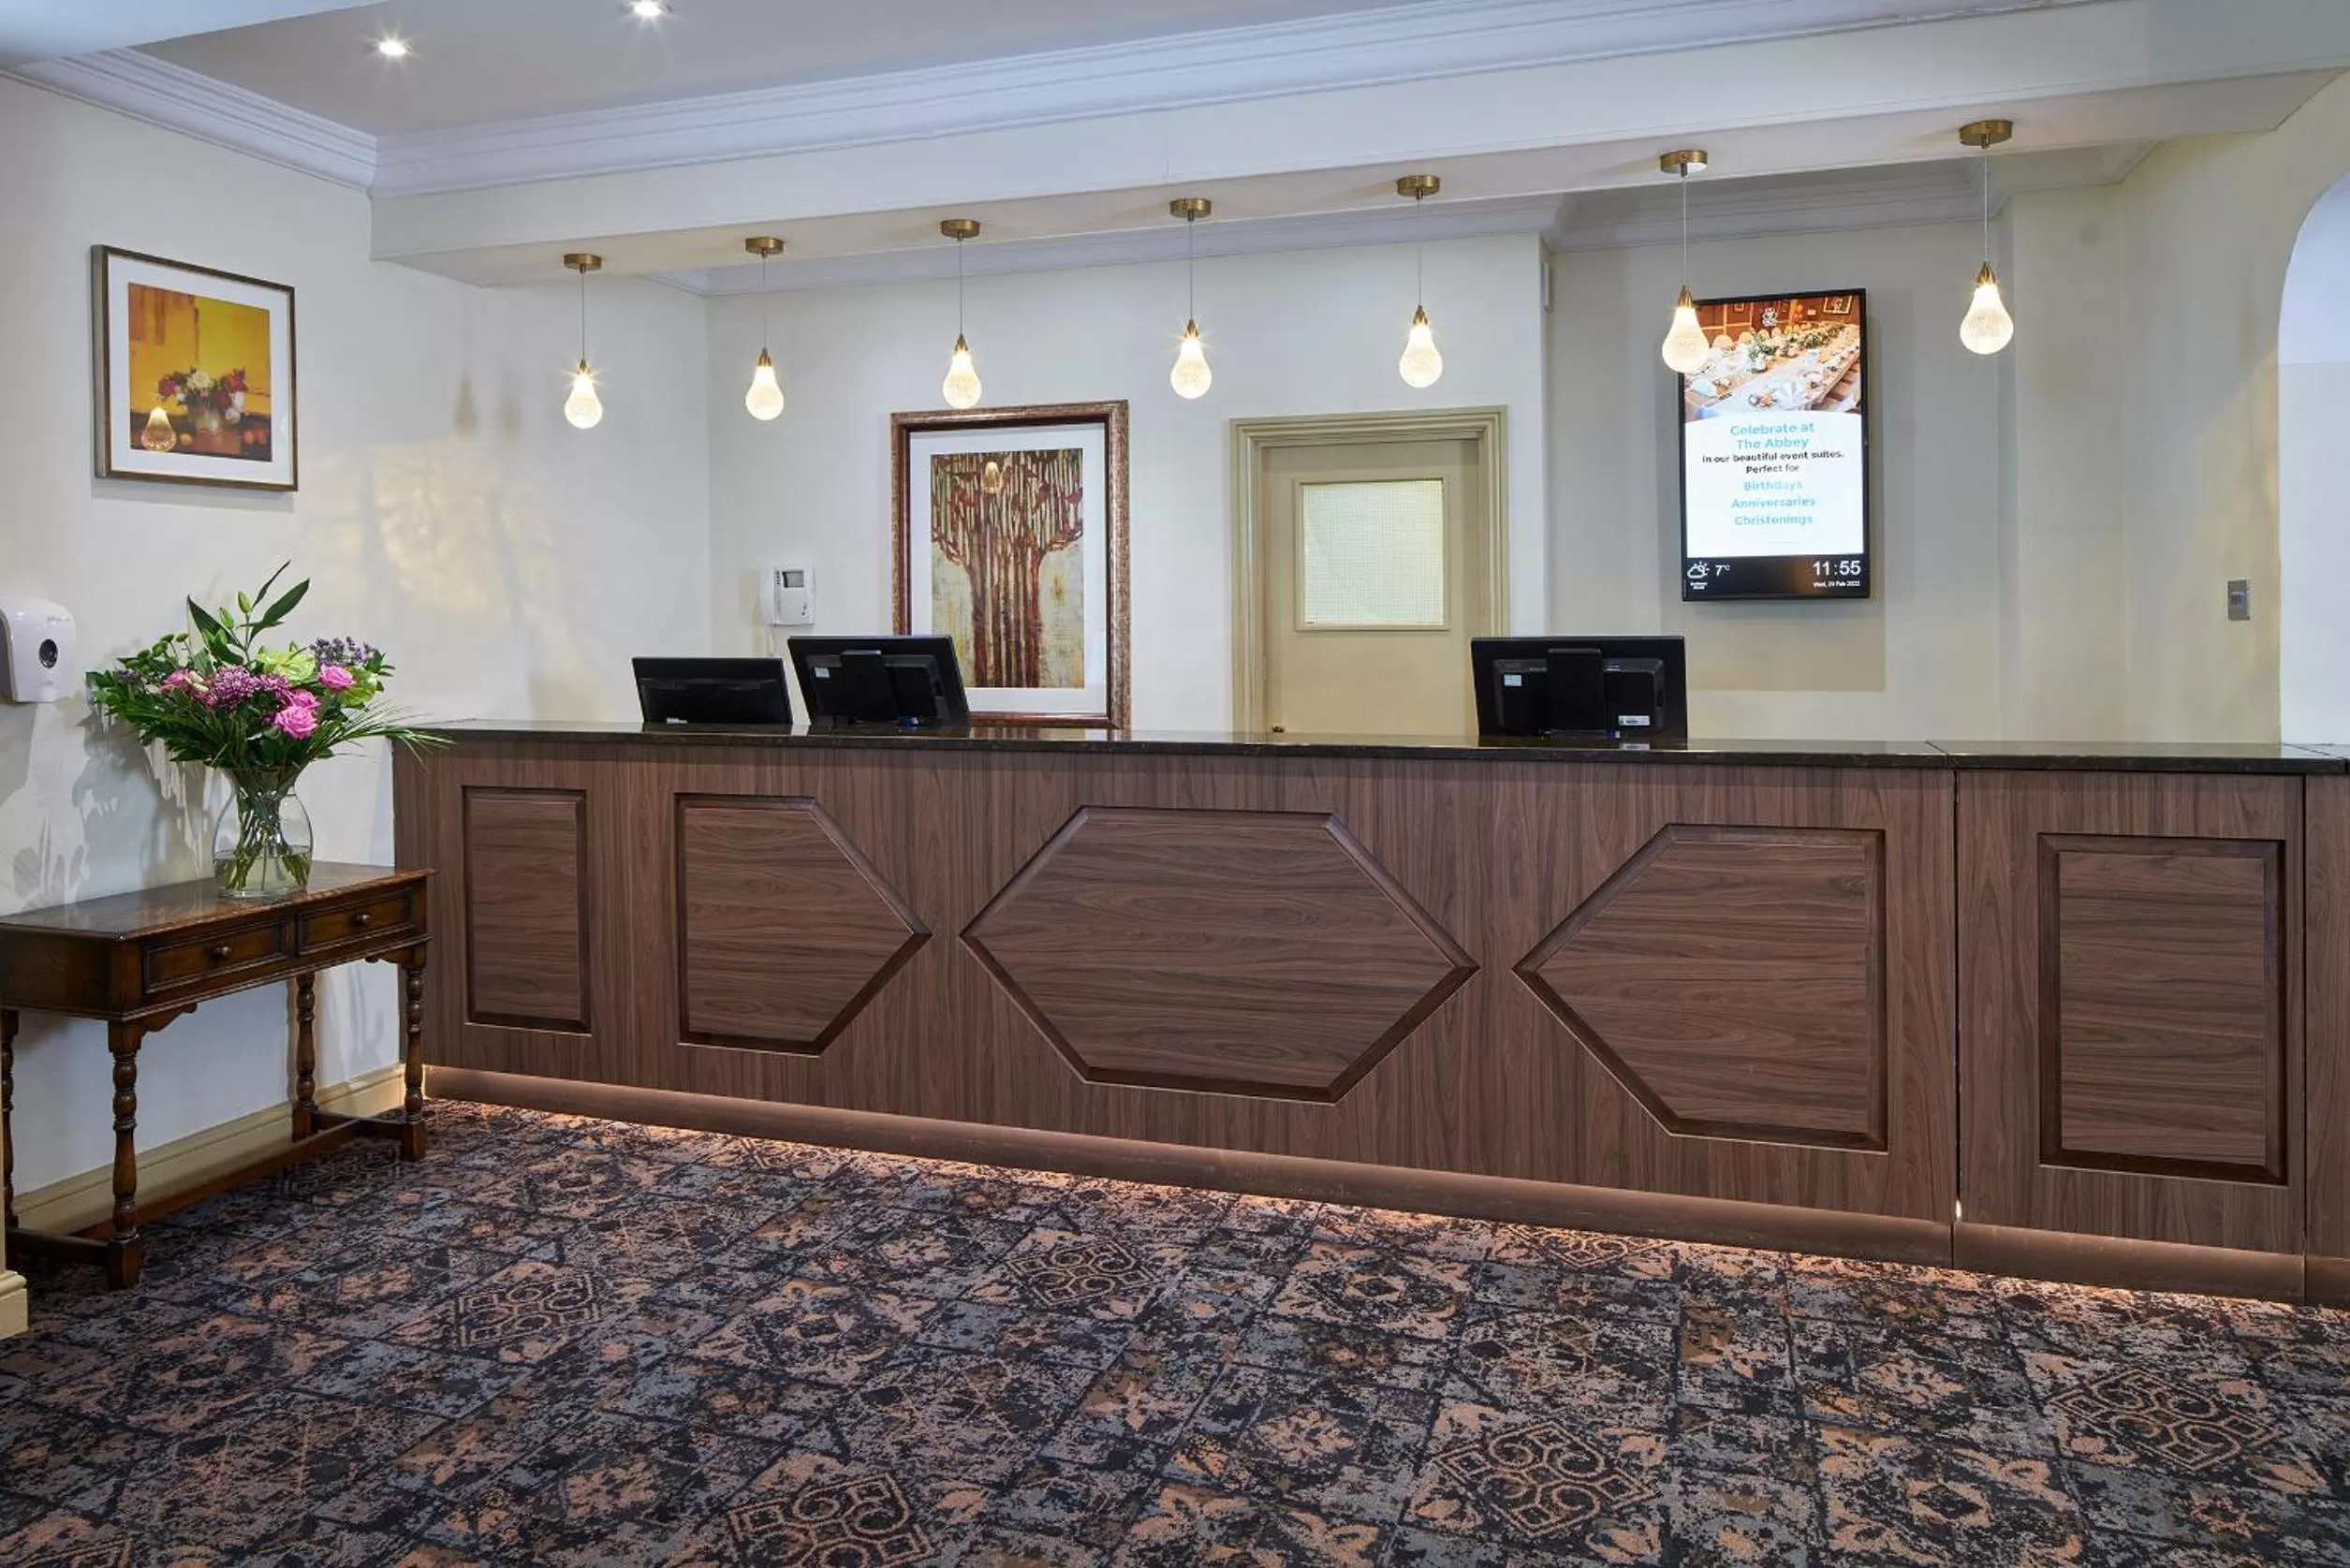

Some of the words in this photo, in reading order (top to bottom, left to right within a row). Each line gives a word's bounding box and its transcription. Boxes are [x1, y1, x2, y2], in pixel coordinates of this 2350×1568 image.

[1730, 422, 1798, 436] Celebrate
[1800, 422, 1814, 433] at
[1736, 438, 1761, 449] The
[1765, 436, 1810, 449] Abbey
[1733, 451, 1778, 462] beautiful
[1779, 450, 1808, 461] event
[1743, 480, 1803, 491] Birthdays
[1730, 497, 1816, 508] Anniversaries
[1734, 514, 1814, 526] Christenings
[1813, 560, 1861, 577] 11:55
